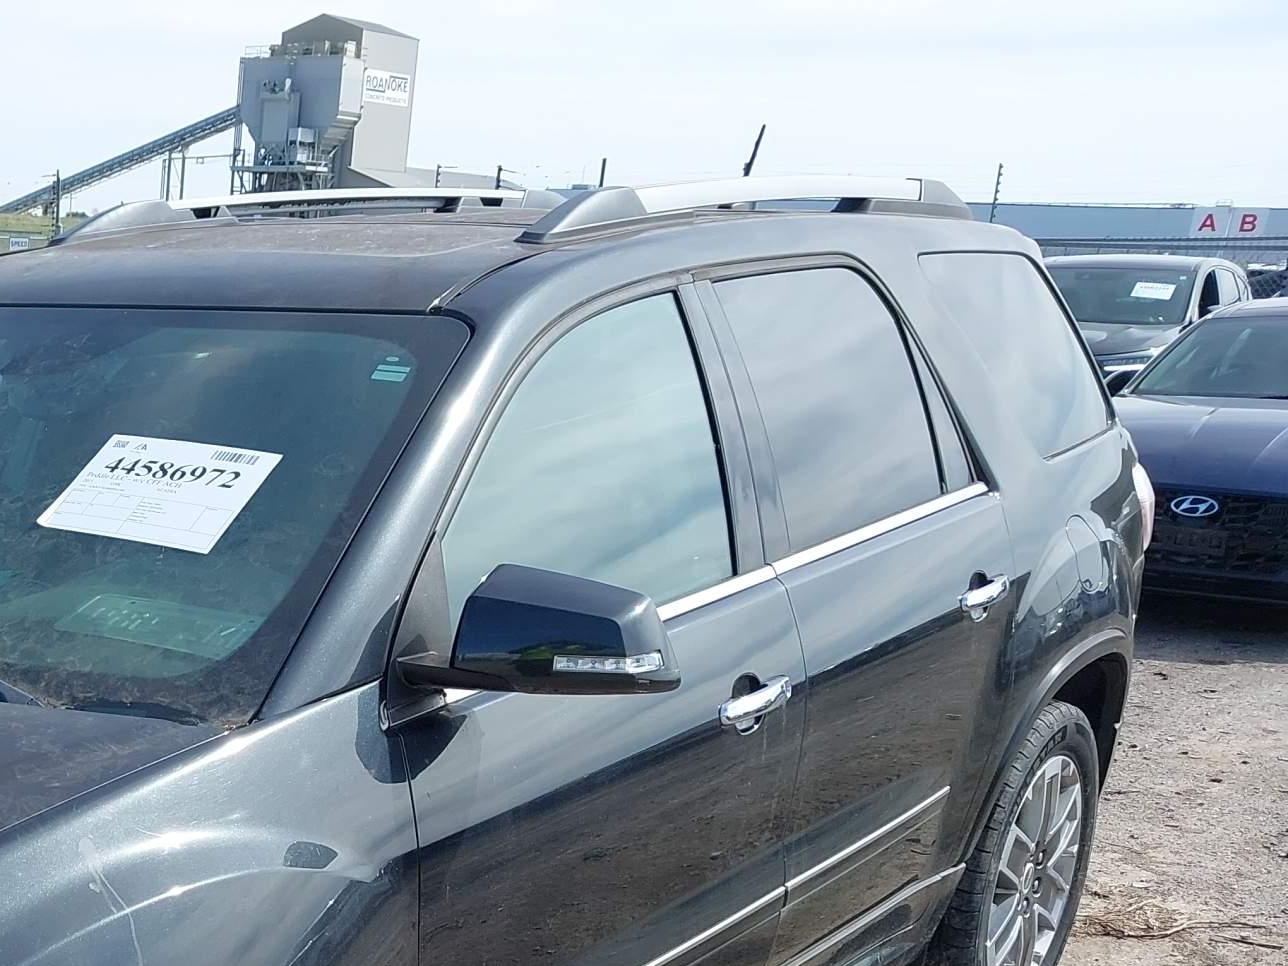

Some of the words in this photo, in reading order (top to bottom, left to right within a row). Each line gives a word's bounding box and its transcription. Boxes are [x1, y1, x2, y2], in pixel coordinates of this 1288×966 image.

[366, 75, 409, 93] ROANOKE
[1198, 213, 1216, 232] A
[1239, 213, 1258, 232] B
[104, 456, 242, 489] 44586972
